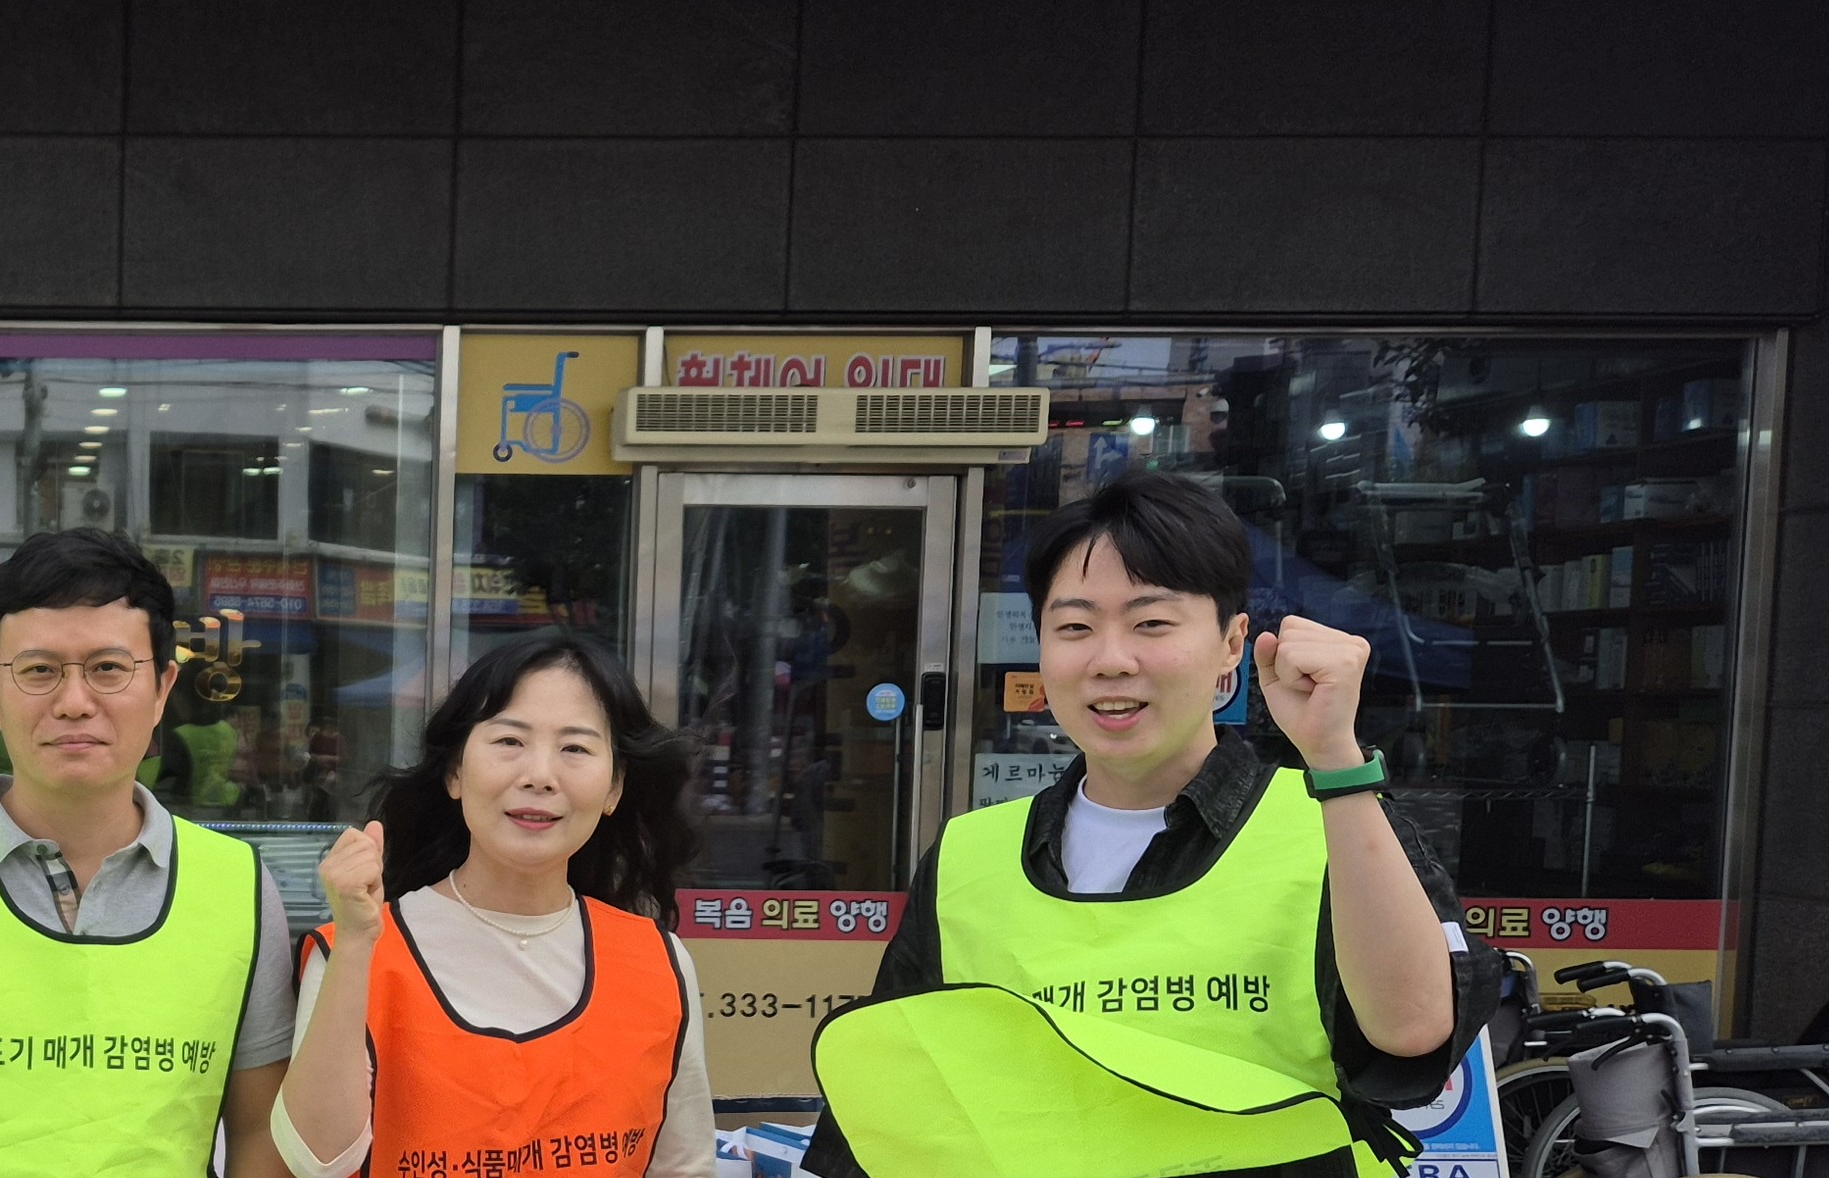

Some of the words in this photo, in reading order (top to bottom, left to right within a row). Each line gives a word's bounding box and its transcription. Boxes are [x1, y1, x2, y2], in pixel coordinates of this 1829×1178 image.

[694, 897, 753, 930] 복음
[761, 898, 821, 930] 의료
[828, 898, 889, 934] 양행
[1464, 905, 1531, 938] 의료
[1541, 906, 1609, 942] 양행
[1097, 975, 1195, 1012] 감염병
[1207, 973, 1270, 1012] 예방
[44, 1034, 94, 1069] 매개
[104, 1036, 174, 1072] 감염병
[182, 1040, 216, 1074] 예방
[550, 1131, 619, 1168] 감염병
